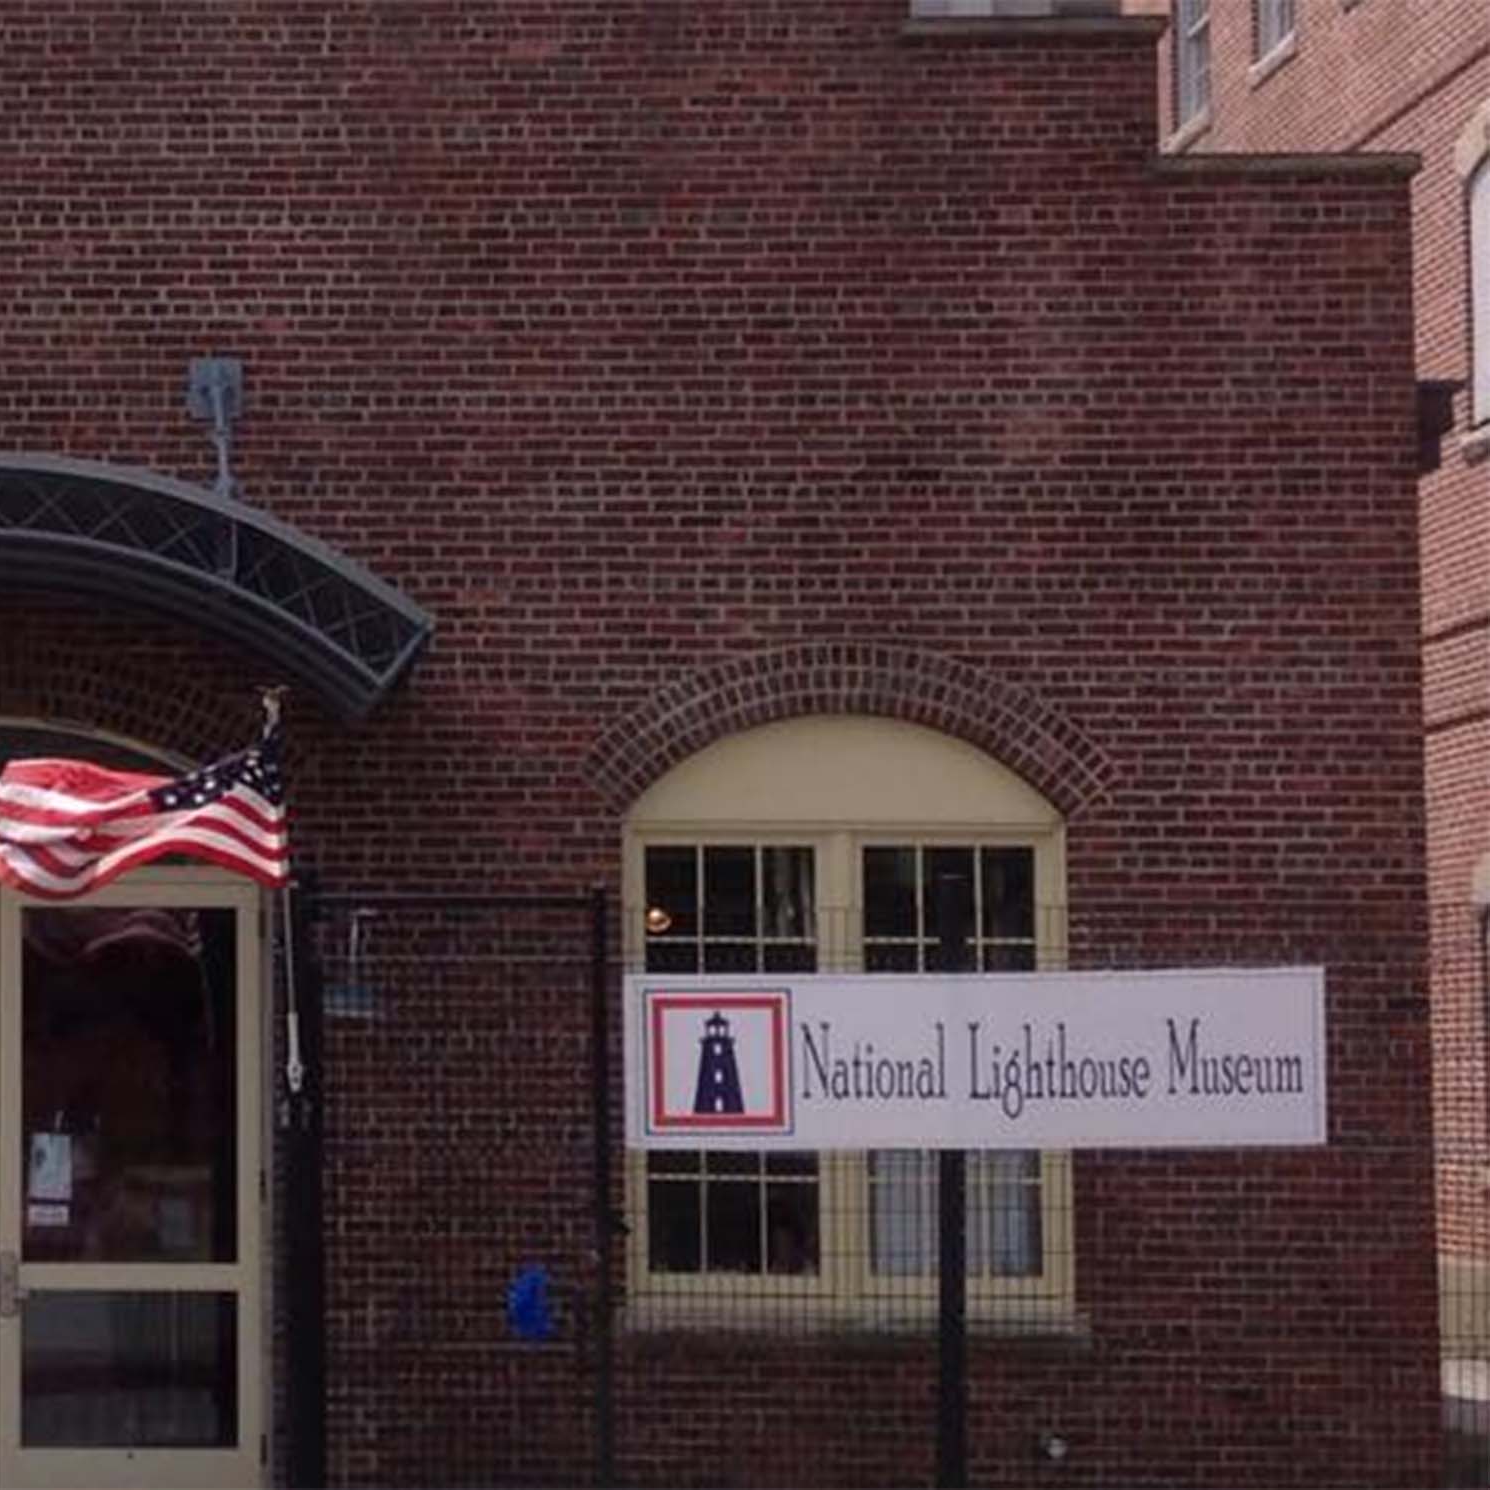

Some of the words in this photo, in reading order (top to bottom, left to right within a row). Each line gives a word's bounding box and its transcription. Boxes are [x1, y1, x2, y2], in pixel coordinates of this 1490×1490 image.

[799, 1019, 948, 1101] National
[967, 1019, 1151, 1119] Lighthouse
[1166, 1017, 1304, 1098] Museum
